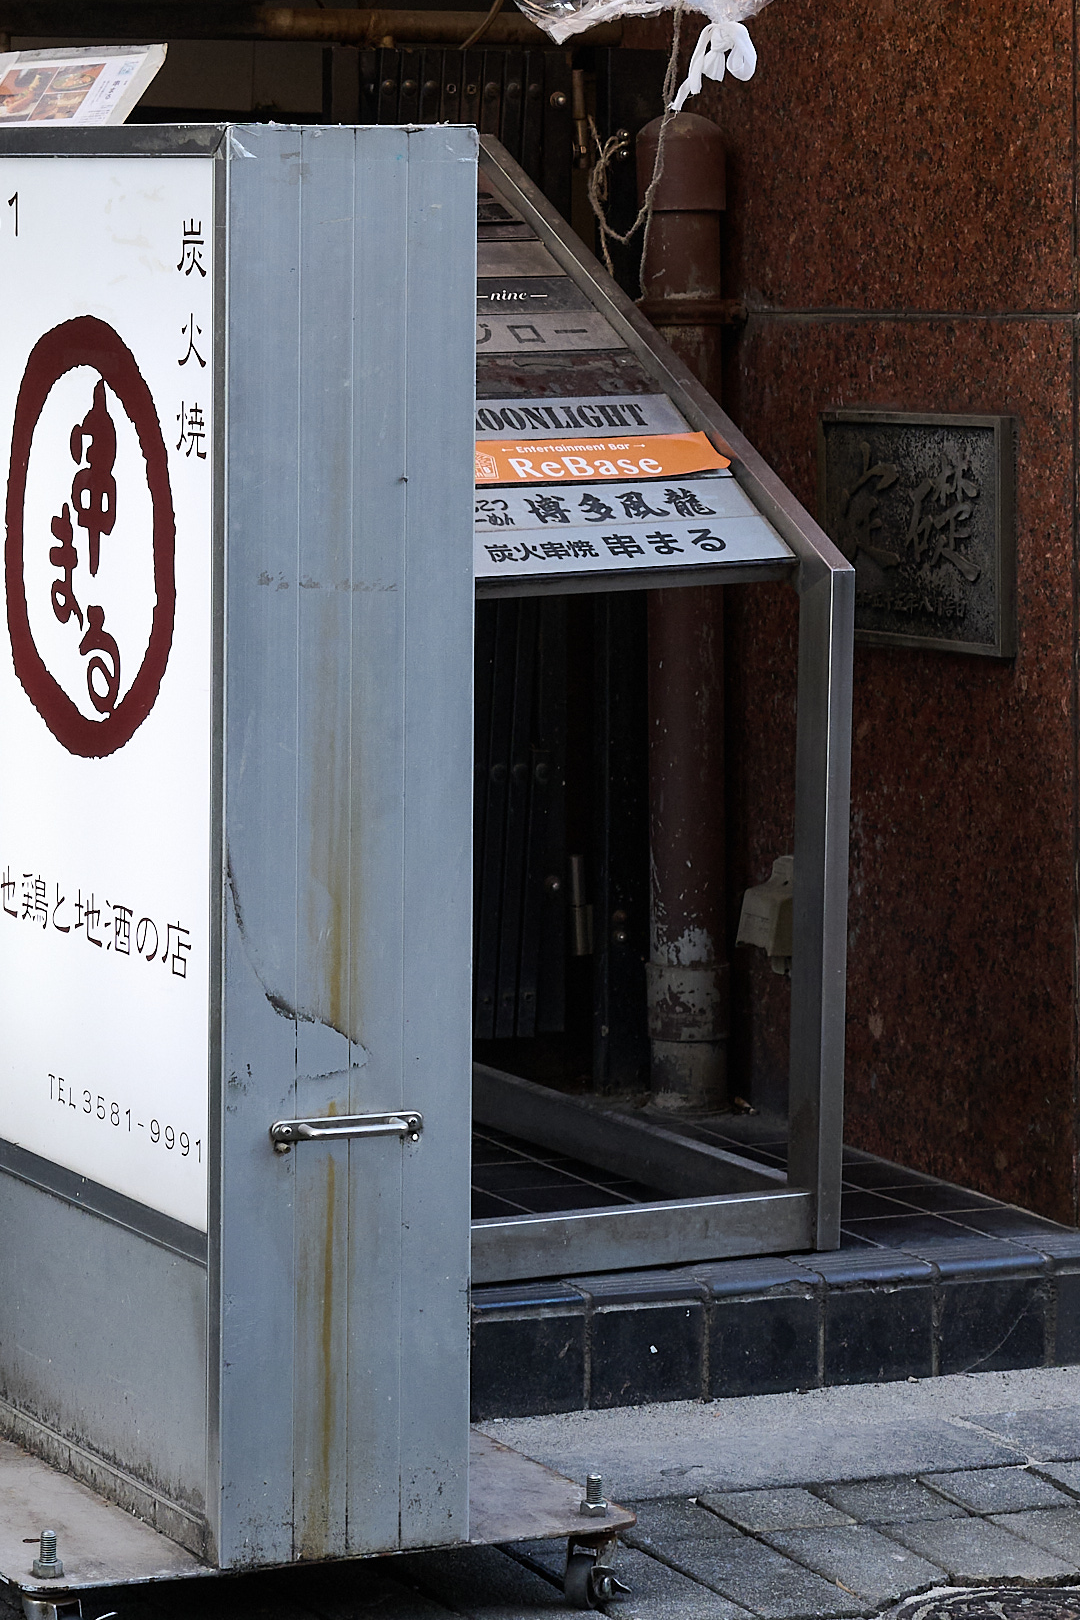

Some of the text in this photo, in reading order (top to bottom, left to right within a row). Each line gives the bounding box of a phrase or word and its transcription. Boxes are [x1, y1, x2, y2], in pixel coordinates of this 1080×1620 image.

[490, 289, 527, 301] nine
[175, 217, 208, 461] 炭火焼
[476, 403, 649, 431] OONLIGHT
[515, 442, 631, 455] Entertainment Bar
[507, 455, 663, 479] ReBase
[523, 486, 717, 526] 博多風龍
[49, 378, 121, 718] 串まる
[484, 527, 729, 564] 炭火串焼 串まる
